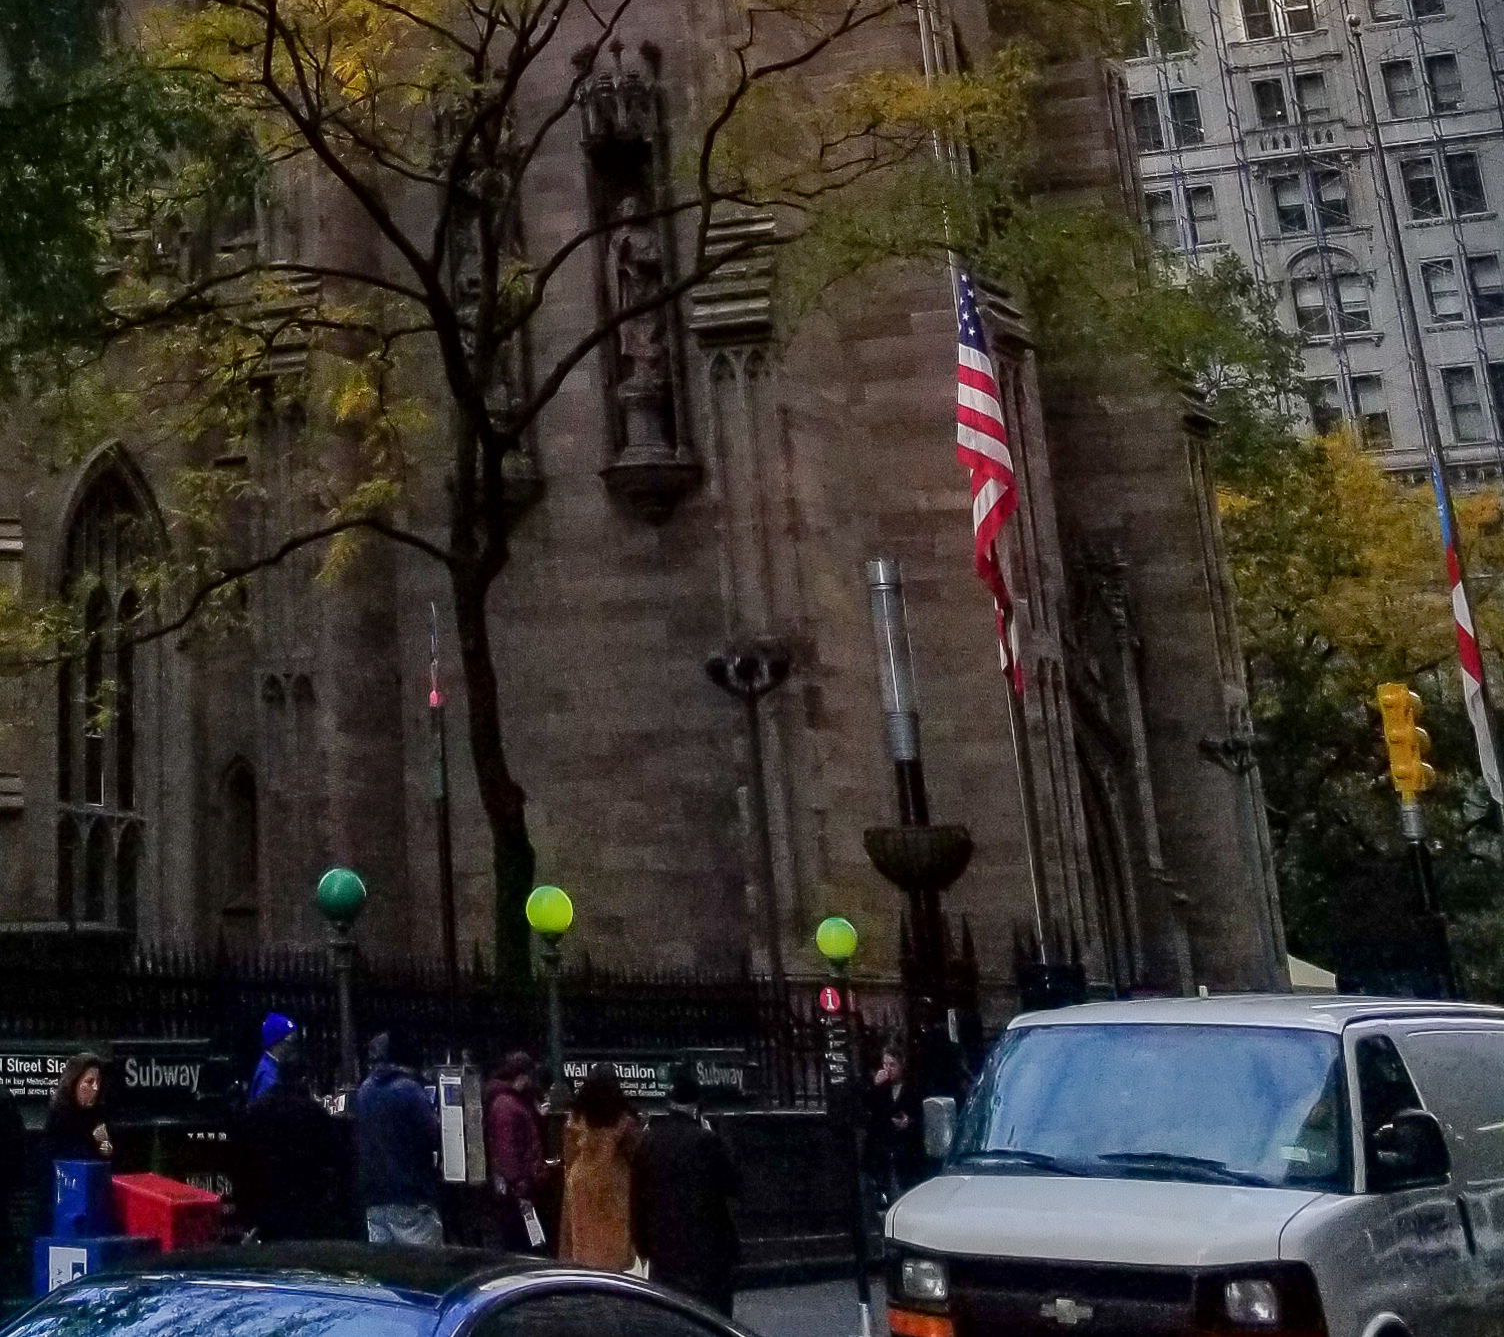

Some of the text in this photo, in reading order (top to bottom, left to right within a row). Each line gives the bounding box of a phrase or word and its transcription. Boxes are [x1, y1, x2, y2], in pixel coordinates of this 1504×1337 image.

[7, 1057, 42, 1073] Street
[125, 1057, 201, 1093] Subway
[563, 1063, 588, 1077] Wall
[697, 1061, 744, 1089] Subway
